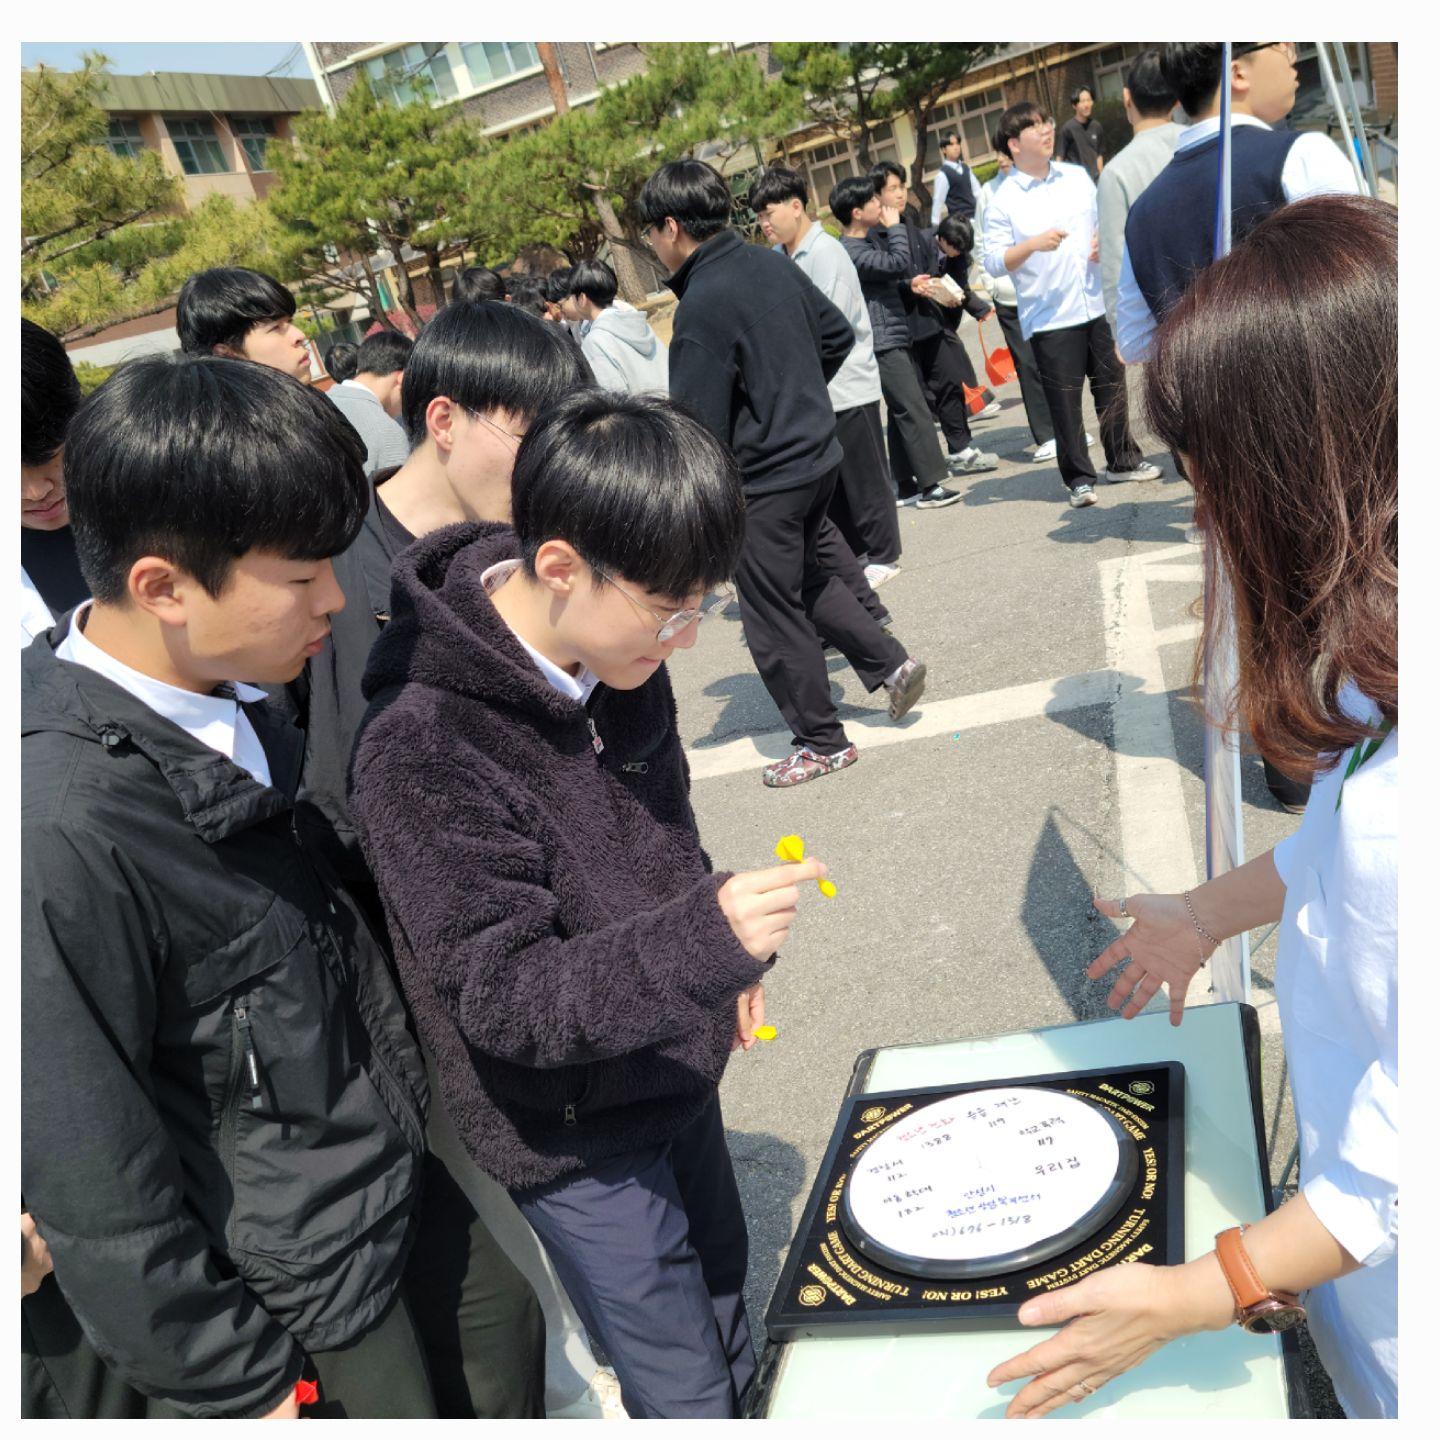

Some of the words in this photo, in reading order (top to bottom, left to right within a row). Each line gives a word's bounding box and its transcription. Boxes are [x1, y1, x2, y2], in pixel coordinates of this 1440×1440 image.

[1099, 1083, 1155, 1112] DARTPOWER
[853, 1102, 913, 1139] DARTPOWER
[1122, 1119, 1147, 1141] GAME
[1142, 1147, 1157, 1168] YES!
[1145, 1168, 1157, 1183] OR
[1141, 1182, 1157, 1200] NO!
[1100, 1208, 1146, 1251] TURNING
[845, 1255, 862, 1274] DART
[1068, 1248, 1104, 1276] DART
[806, 1263, 857, 1306] DARTPOWER
[858, 1268, 910, 1296] TURNING
[1026, 1265, 1068, 1290] GAME
[921, 1290, 948, 1301] NO!
[951, 1292, 972, 1301] OR
[975, 1286, 1008, 1299] YES!
